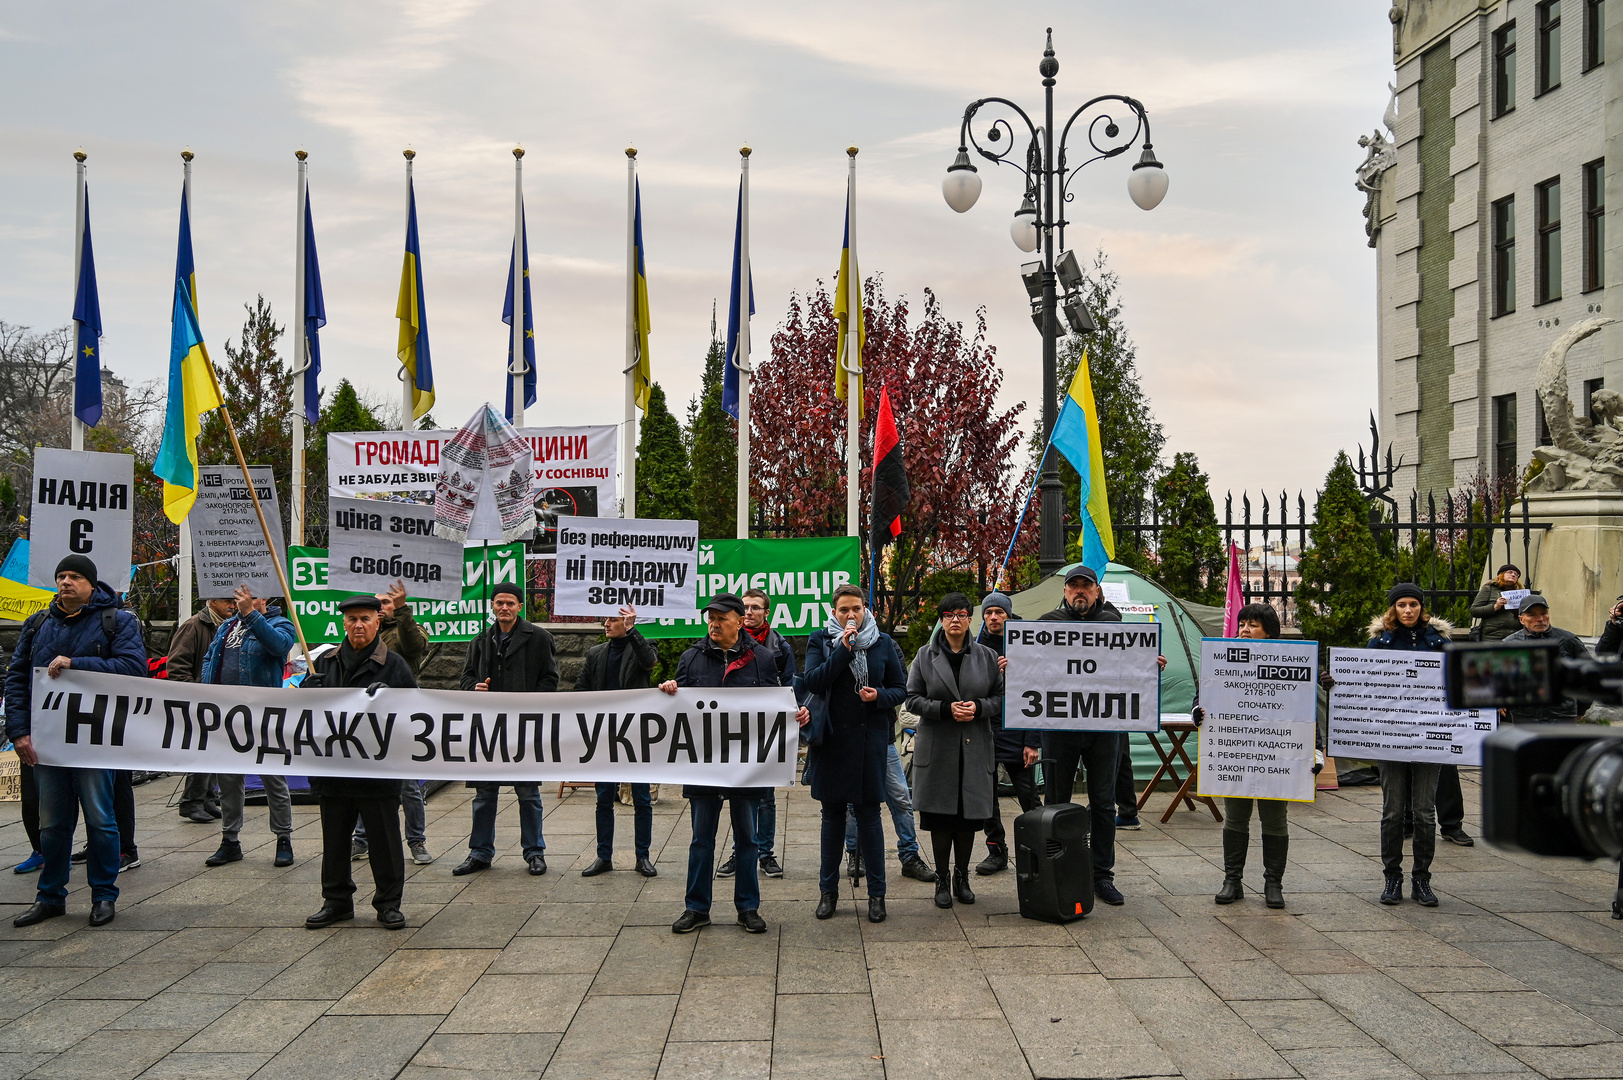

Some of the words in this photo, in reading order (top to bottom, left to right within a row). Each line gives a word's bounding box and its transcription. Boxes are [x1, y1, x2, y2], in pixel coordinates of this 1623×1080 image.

[355, 440, 450, 466] ГРОМАД
[525, 435, 588, 463] ЩИНИ
[204, 475, 221, 486] НЕ
[339, 475, 356, 485] НЕ
[359, 474, 408, 485] ЗАБУДЕ
[410, 472, 438, 482] ЗВІР
[535, 470, 544, 479] У
[546, 468, 608, 479] СОСНІВЦІ
[38, 478, 127, 511] НАДІЯ
[336, 508, 382, 531] ціна
[390, 516, 438, 536] зем
[69, 519, 93, 554] Є
[561, 528, 586, 544] без
[591, 531, 696, 551] референдуму
[350, 554, 441, 583] свобода
[566, 555, 586, 580] ні
[592, 560, 688, 587] продажу
[588, 585, 664, 606] землі
[697, 571, 850, 600] ПРИЄМЦІВ
[405, 599, 494, 618] ПРИЄМЦ
[1008, 630, 1157, 650] РЕФЕРЕНДУМ
[1229, 650, 1248, 661] НЕ
[1214, 669, 1243, 678] ЗЕМЛІ,
[1259, 667, 1307, 680] ПРОТИ
[1224, 681, 1297, 691] ЗАКОНОПРОЕКТУ
[1021, 691, 1140, 720] ЗЕМЛІ
[1238, 701, 1284, 710] СПОЧАТКУ:
[161, 699, 397, 766] ПРОДАЖУ
[410, 712, 562, 763] ЗЕМЛІ
[576, 700, 787, 764] УКРАЇНИ
[1218, 726, 1292, 736] ІНВЕНТАРИЗАЦІЯ
[1257, 741, 1302, 749] КАДАСТРИ
[1218, 752, 1276, 761] РЕФЕРЕНДУМ
